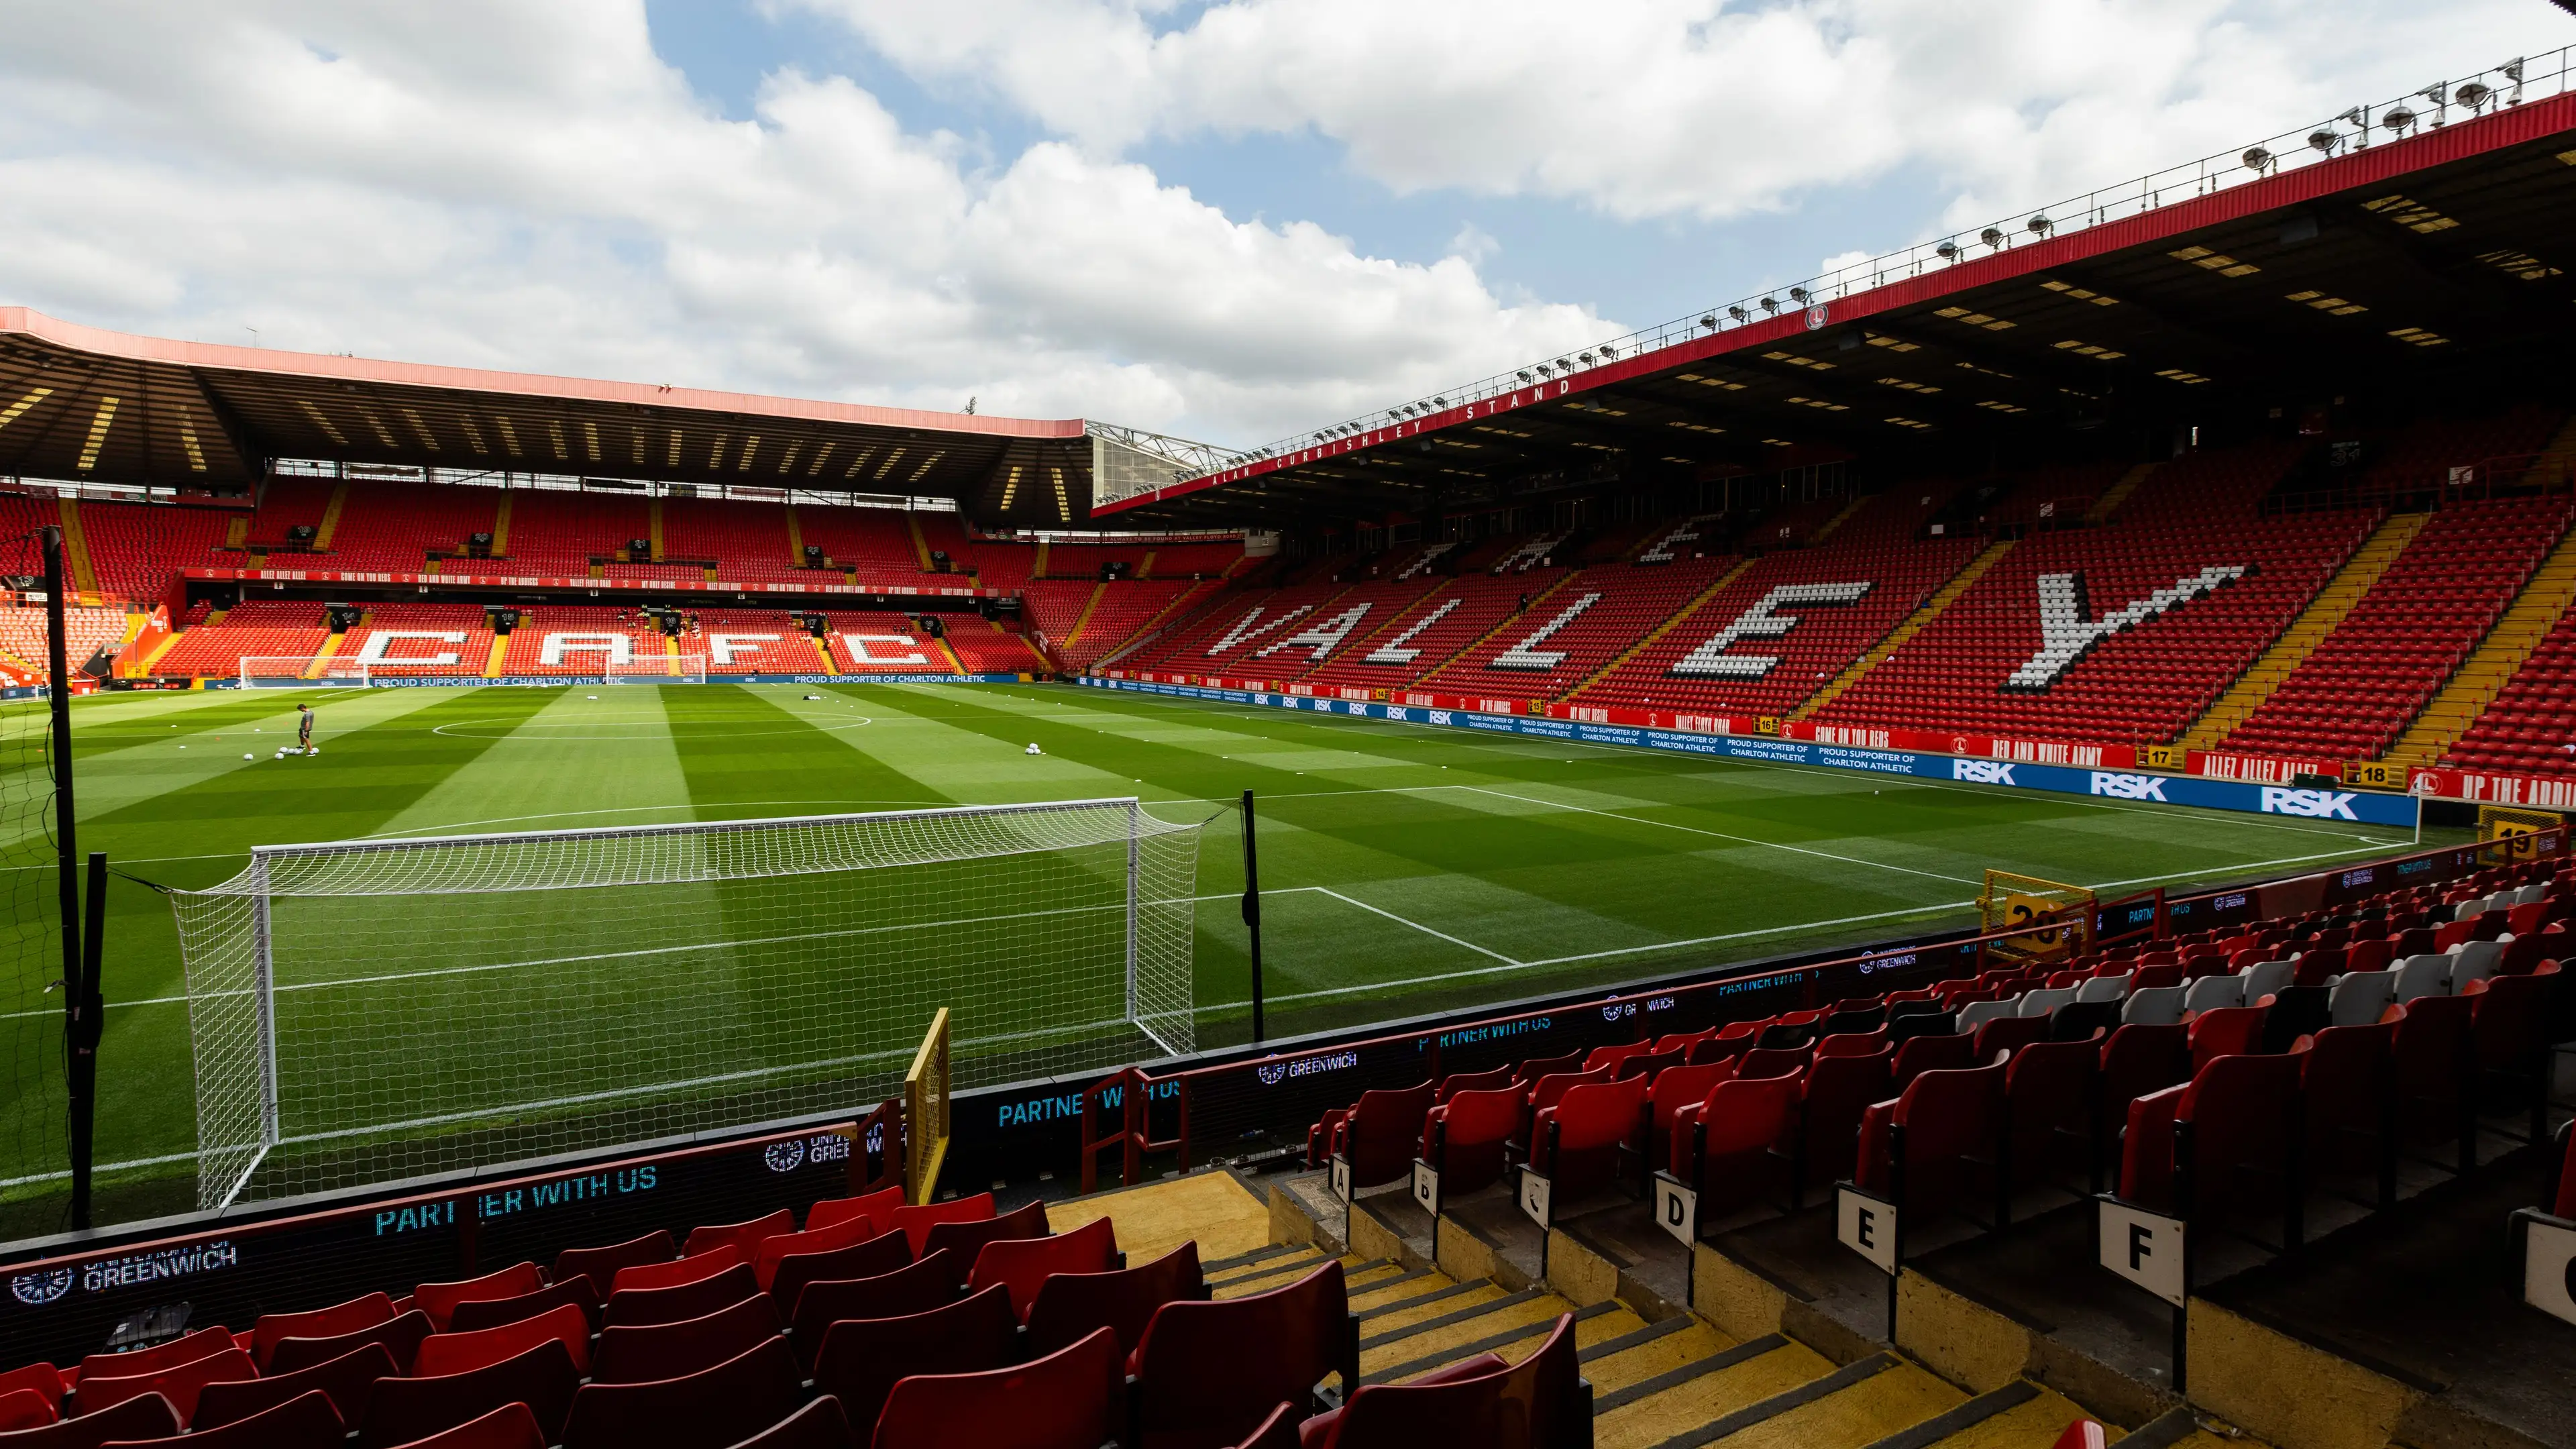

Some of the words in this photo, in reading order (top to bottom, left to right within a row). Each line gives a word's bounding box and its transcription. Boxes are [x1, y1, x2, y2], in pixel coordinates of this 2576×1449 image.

[1213, 467, 1249, 484] ALAN
[1277, 421, 1421, 468] CURBISHLEY
[1467, 380, 1569, 419] STAND
[260, 570, 274, 579] ALLEZ
[276, 570, 290, 580] ALLEZ
[292, 571, 306, 580] ALLEZ
[341, 572, 355, 581] COME
[357, 573, 365, 582] ON
[366, 573, 376, 582] YOU
[378, 573, 390, 582] REDS
[418, 574, 427, 583] RED
[429, 575, 439, 584] AND
[441, 575, 455, 584] WHITE
[458, 575, 470, 584] ARMY
[500, 576, 507, 585] UP
[508, 577, 517, 585] THE
[661, 581, 676, 589] DESIRE
[707, 582, 718, 590] ALLEZ
[719, 582, 729, 590] ALLEZ
[375, 679, 417, 687] PROUD
[421, 678, 488, 686] SUPPORTER
[492, 678, 508, 686] OF
[511, 678, 571, 686] CHARLTON
[1093, 679, 1102, 687] RSK
[1109, 680, 1118, 688] RSK
[1254, 694, 1269, 705] RSK
[1283, 696, 1299, 708] RSK
[1314, 699, 1332, 712] RSK
[1406, 693, 1415, 704] ALLEZ
[1415, 694, 1424, 705] ALLEZ
[1424, 695, 1433, 706] ALLEZ
[1480, 699, 1485, 711] UP
[1494, 700, 1511, 714] ADDICKS
[1348, 702, 1367, 716] RSK
[1387, 706, 1407, 720] RSK
[1570, 706, 1577, 719] MY
[1578, 707, 1590, 721] ONLY
[1591, 708, 1608, 722] DESIRE
[1429, 710, 1452, 725] RSK
[1676, 714, 1693, 730] VALLEY
[1695, 716, 1712, 733] FLOYD
[1714, 718, 1730, 734] ROAD
[1469, 721, 1491, 729] CHARLTON
[1492, 723, 1513, 731] ATHLETIC
[1522, 727, 1546, 735] CHARLTON
[1537, 721, 1565, 729] SUPPORTER
[1599, 727, 1630, 736] SUPPORTER
[1762, 720, 1770, 730] 16
[1582, 733, 1611, 742] CHARLTON
[1611, 736, 1638, 745] ATHLETIC
[1648, 731, 1669, 739] PROUD
[1670, 733, 1707, 743] SUPPORTER
[1815, 726, 1835, 743] COME
[1838, 728, 1849, 744] ON
[1852, 729, 1866, 746] YOU
[1869, 730, 1889, 748] REDS
[1651, 740, 1684, 750] CHARLTON
[1685, 744, 1716, 753] ATHLETIC
[1727, 739, 1752, 747] PROUD
[1753, 742, 1795, 751] SUPPORTER
[1731, 749, 1768, 758] CHARLTON
[1770, 752, 1805, 762] ATHLETIC
[1819, 747, 1847, 757] PROUD
[1849, 750, 1900, 762] SUPPORTER
[1992, 739, 2010, 758] RED
[2013, 740, 2033, 761] AND
[2038, 742, 2068, 764] WHITE
[2072, 745, 2103, 767] ARMY
[2152, 751, 2169, 763] 17
[1823, 757, 1868, 769] CHARLTON
[1870, 762, 1912, 773] ATHLETIC
[2202, 755, 2237, 779] ALLEZ
[2241, 758, 2276, 782] ALLEZ
[1953, 759, 2016, 786] RSK
[2364, 767, 2385, 782] 18
[2090, 771, 2167, 802] RSK
[2463, 775, 2485, 800] UP
[2491, 777, 2522, 804] THE
[2261, 786, 2359, 820] RSK
[1876, 954, 1916, 969] GREENWICH
[1289, 1053, 1357, 1077] GREENWICH
[999, 1093, 1083, 1127] PARTNE
[533, 1175, 608, 1207] WITH
[618, 1165, 657, 1193] US
[1336, 1168, 1344, 1193] A
[1668, 1191, 1684, 1228] D
[1858, 1208, 1874, 1249] E
[2129, 1222, 2152, 1271] F
[83, 1246, 237, 1291] GREENWICH
